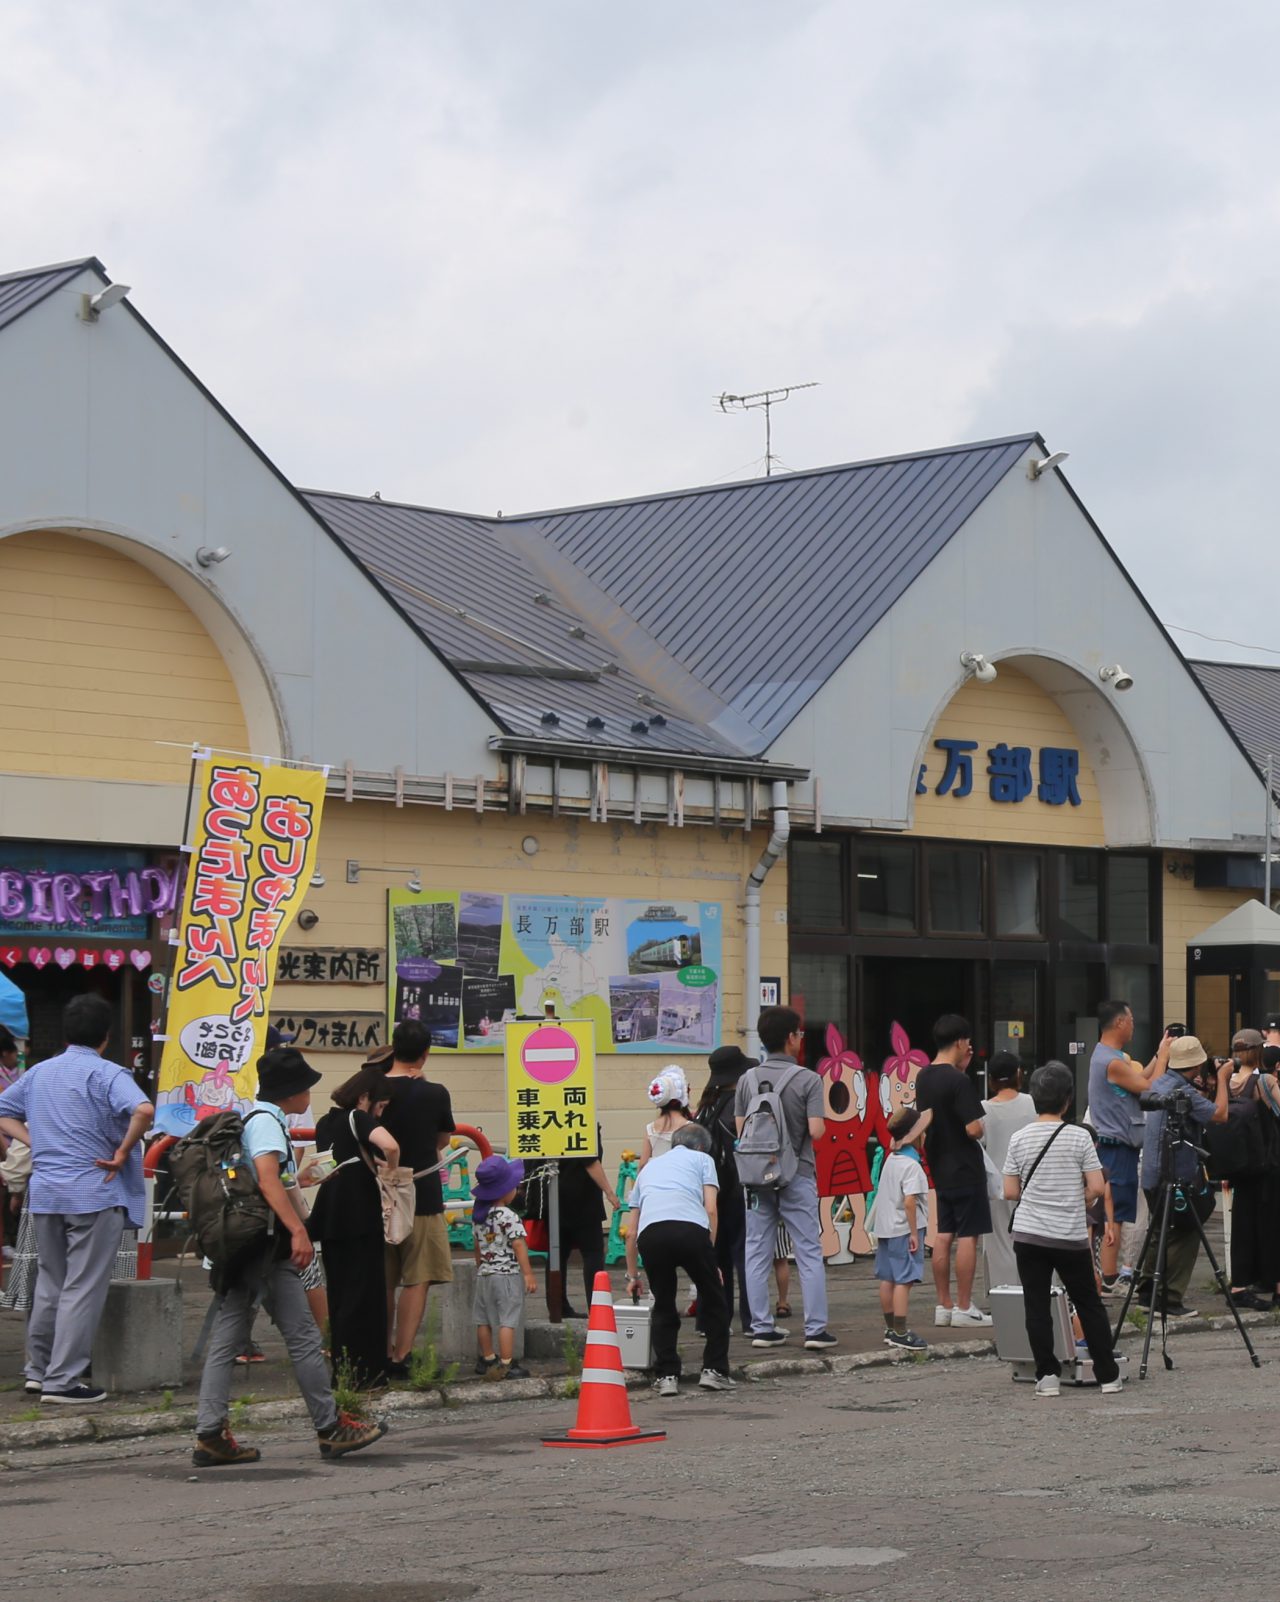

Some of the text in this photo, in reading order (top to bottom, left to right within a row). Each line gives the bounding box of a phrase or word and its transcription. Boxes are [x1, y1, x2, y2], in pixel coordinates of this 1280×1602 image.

[916, 738, 1082, 806] 万部駅
[516, 914, 610, 937] 長万部駅
[278, 951, 380, 981] 光案内所
[517, 1087, 587, 1107] 車両
[517, 1110, 587, 1130] 乗入れ
[518, 1131, 588, 1153] 禁止
